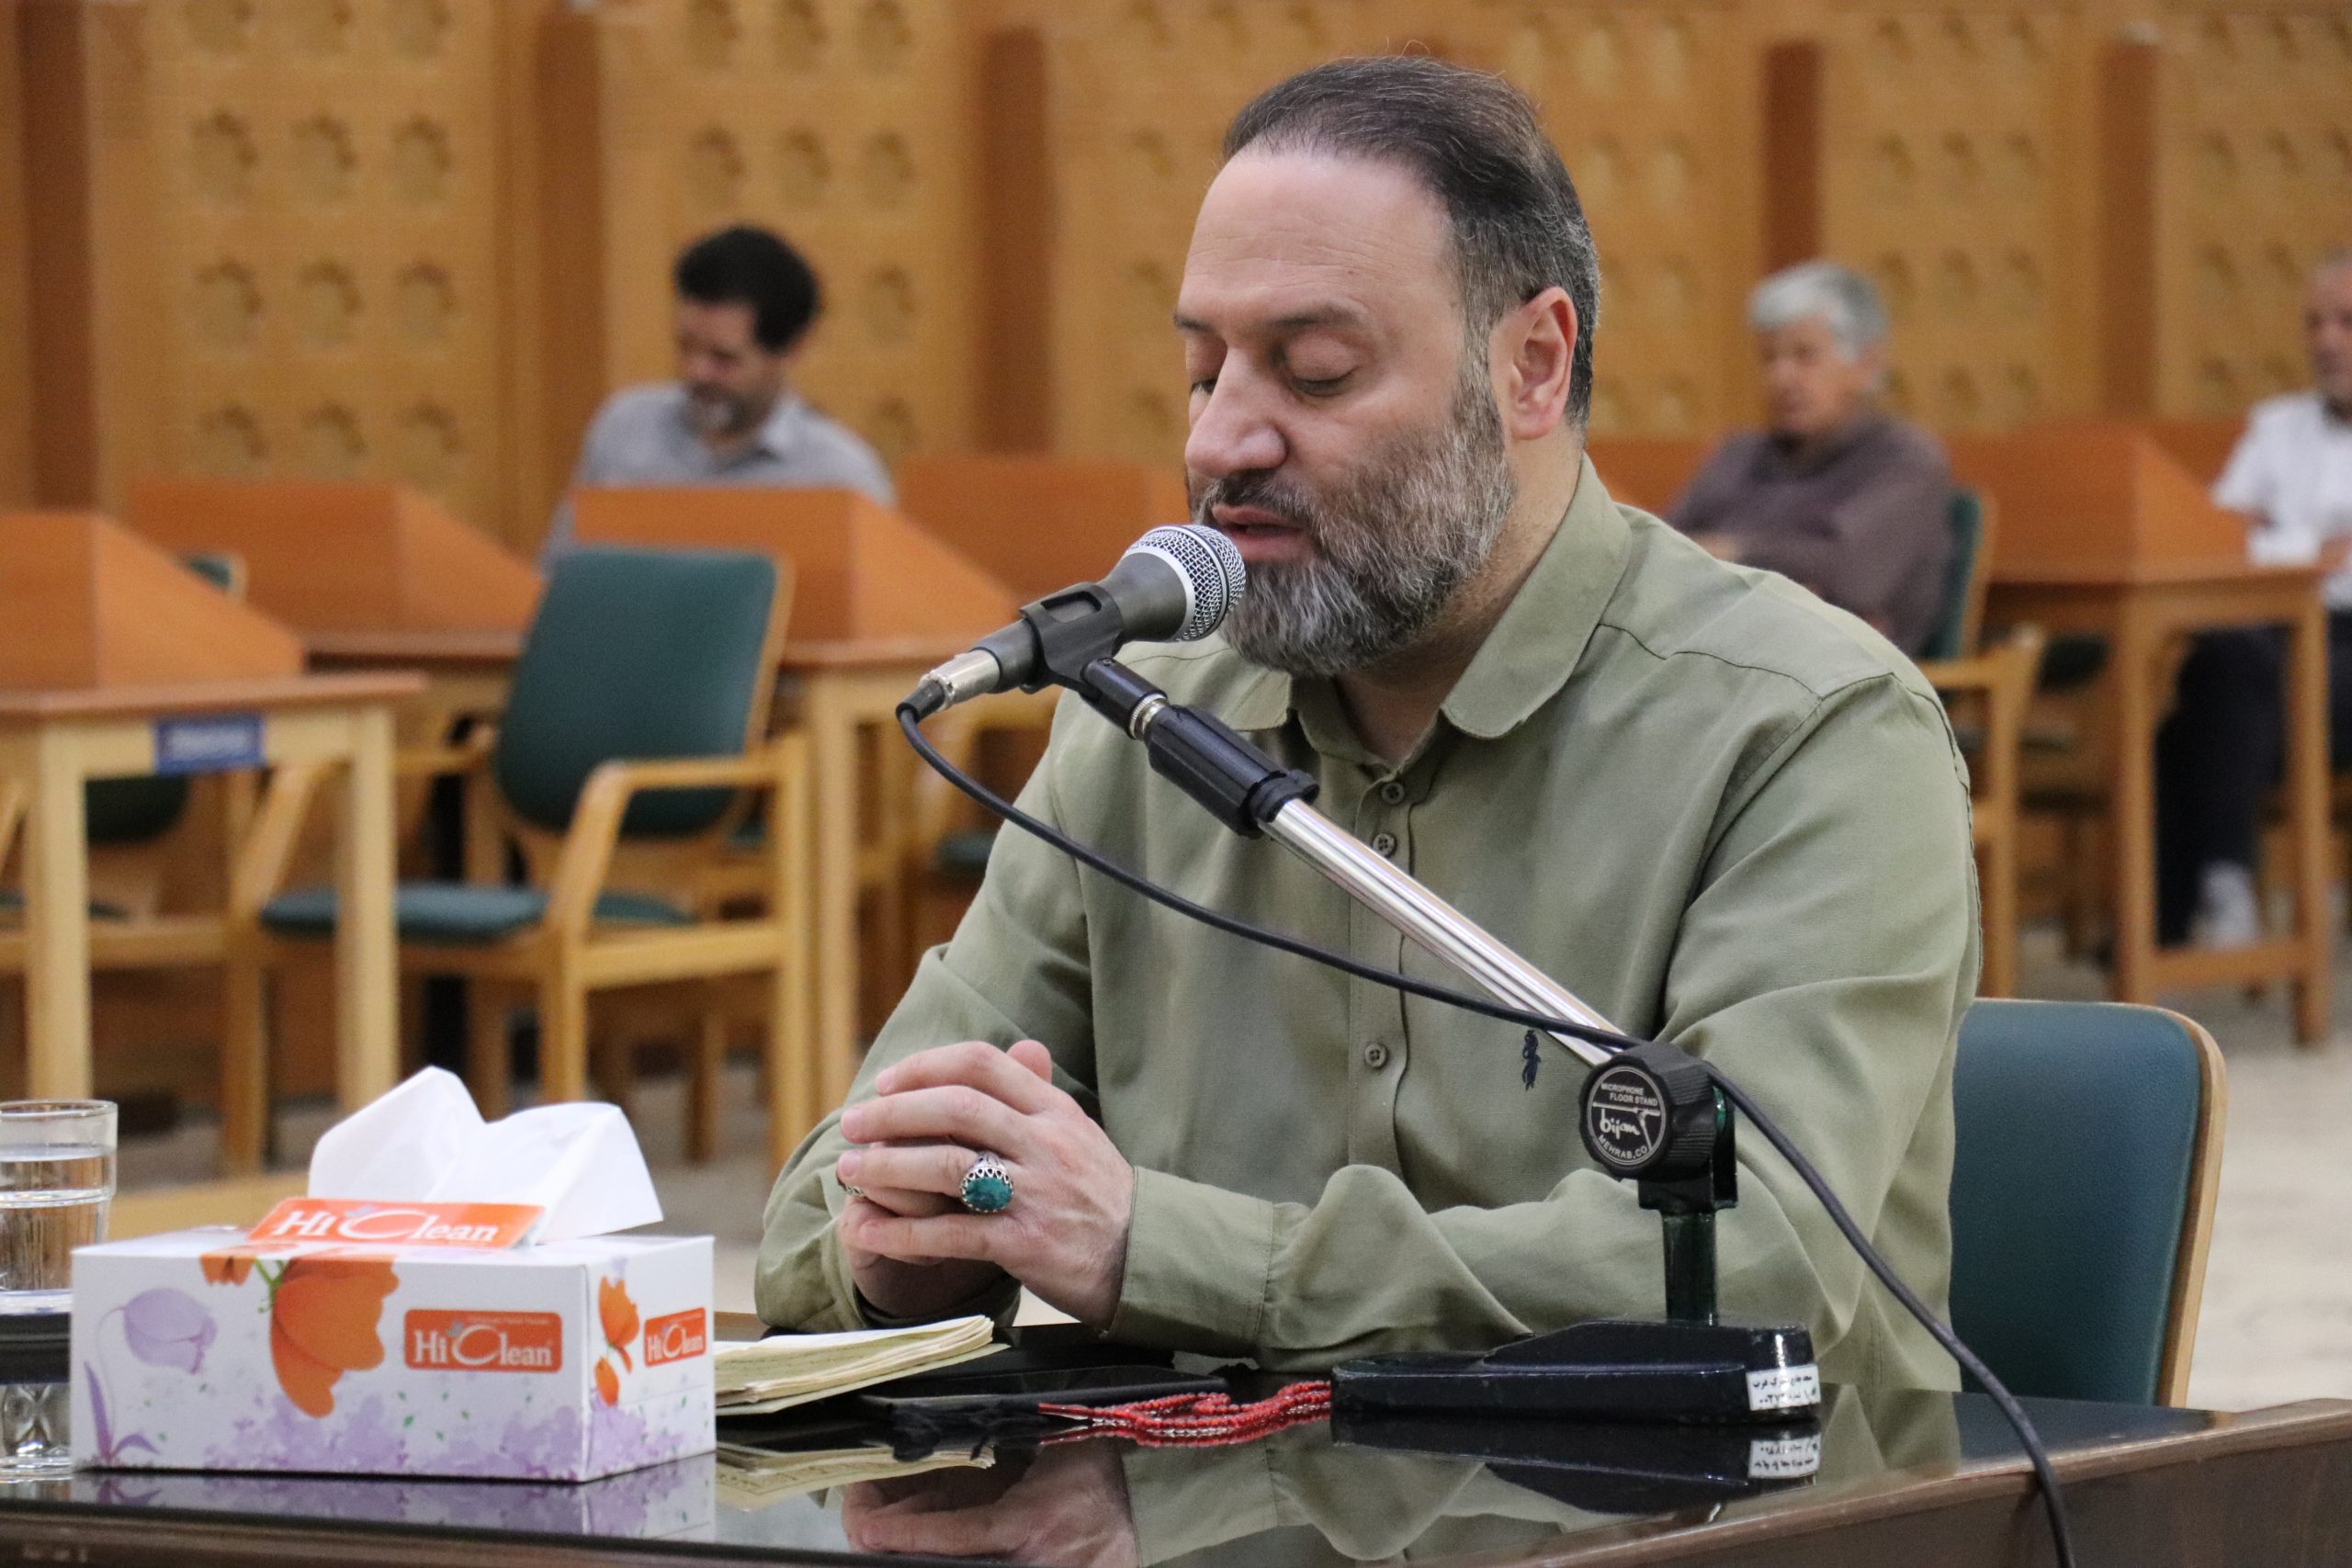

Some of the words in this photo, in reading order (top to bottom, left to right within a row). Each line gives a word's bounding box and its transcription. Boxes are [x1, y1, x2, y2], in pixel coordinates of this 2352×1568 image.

[1600, 1083, 1644, 1095] MICROPHONE
[1610, 1093, 1633, 1103] FLOOR
[1634, 1096, 1658, 1106] STAND
[1600, 1108, 1641, 1140] bijan
[271, 1211, 337, 1236] Hi
[337, 1209, 499, 1242] Clean
[414, 1330, 447, 1363] Hi
[452, 1324, 552, 1367] Clean
